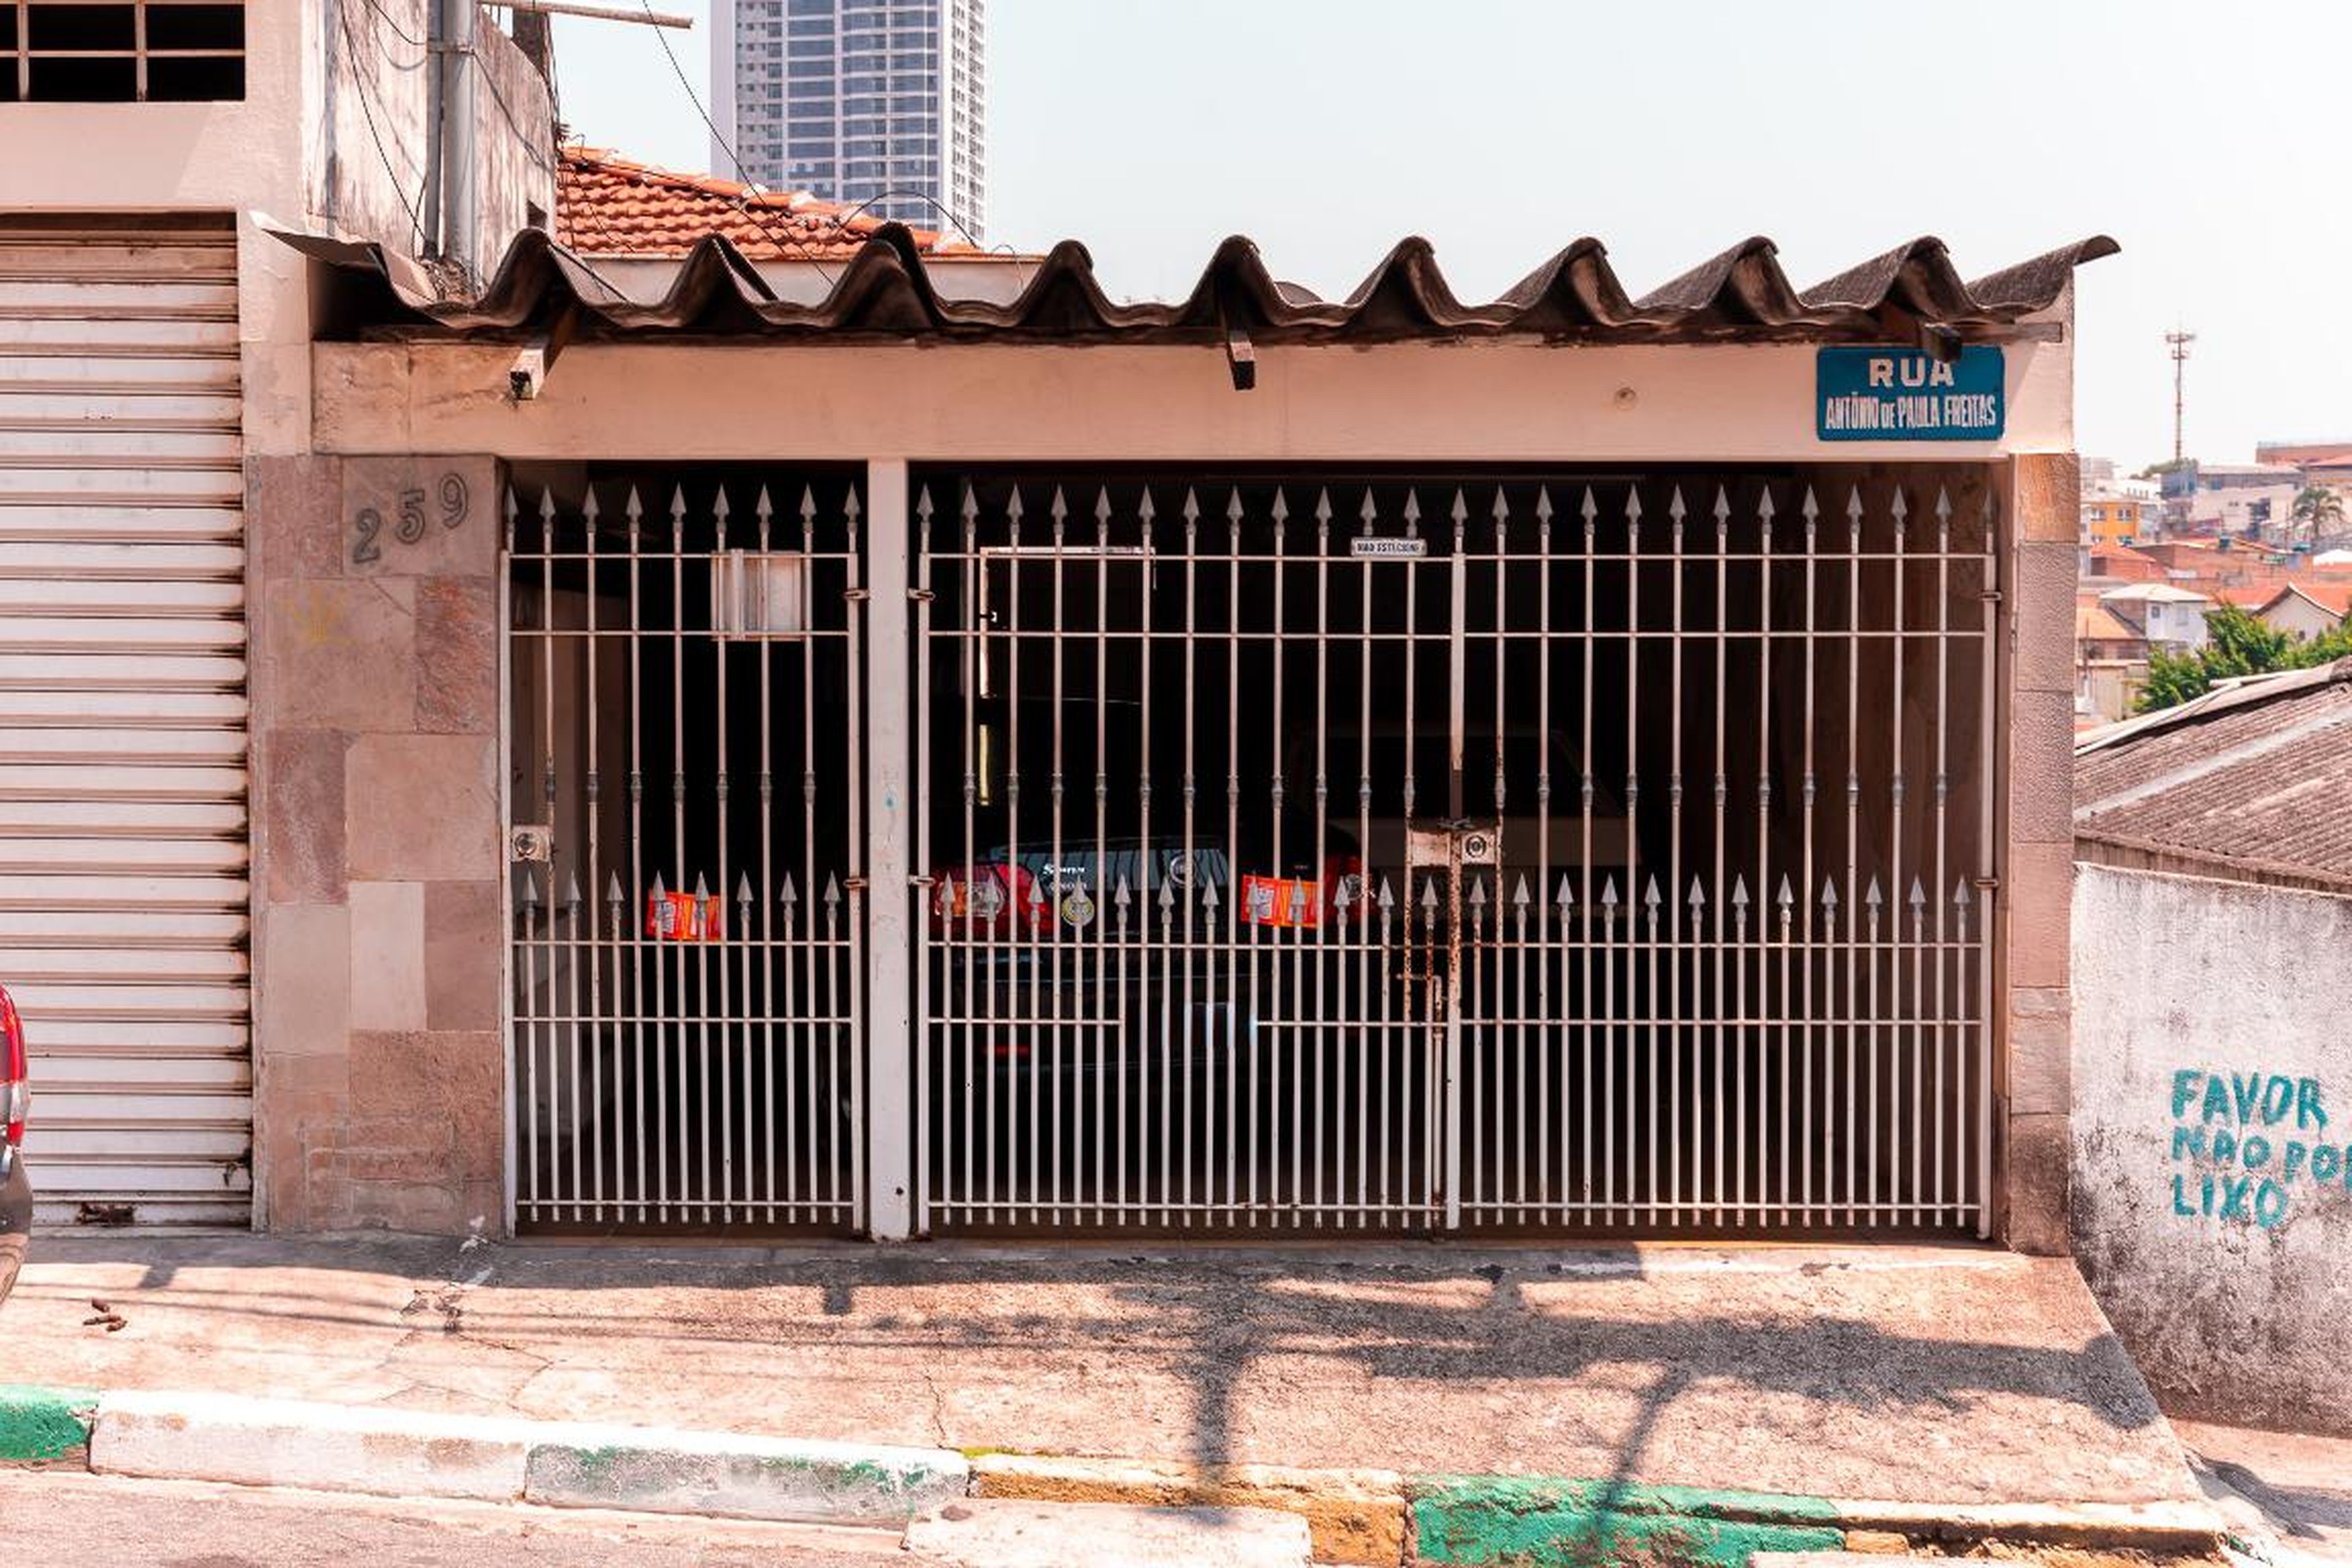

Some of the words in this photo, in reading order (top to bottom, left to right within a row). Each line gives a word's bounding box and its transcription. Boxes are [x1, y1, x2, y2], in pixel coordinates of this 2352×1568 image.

[1869, 358, 1954, 387] RUA
[1898, 395, 1940, 428] PAULA
[1944, 394, 1996, 428] FREITAS
[352, 472, 469, 564] 259
[2172, 1071, 2328, 1129] FAVOR
[2173, 1174, 2287, 1229] LIXO
